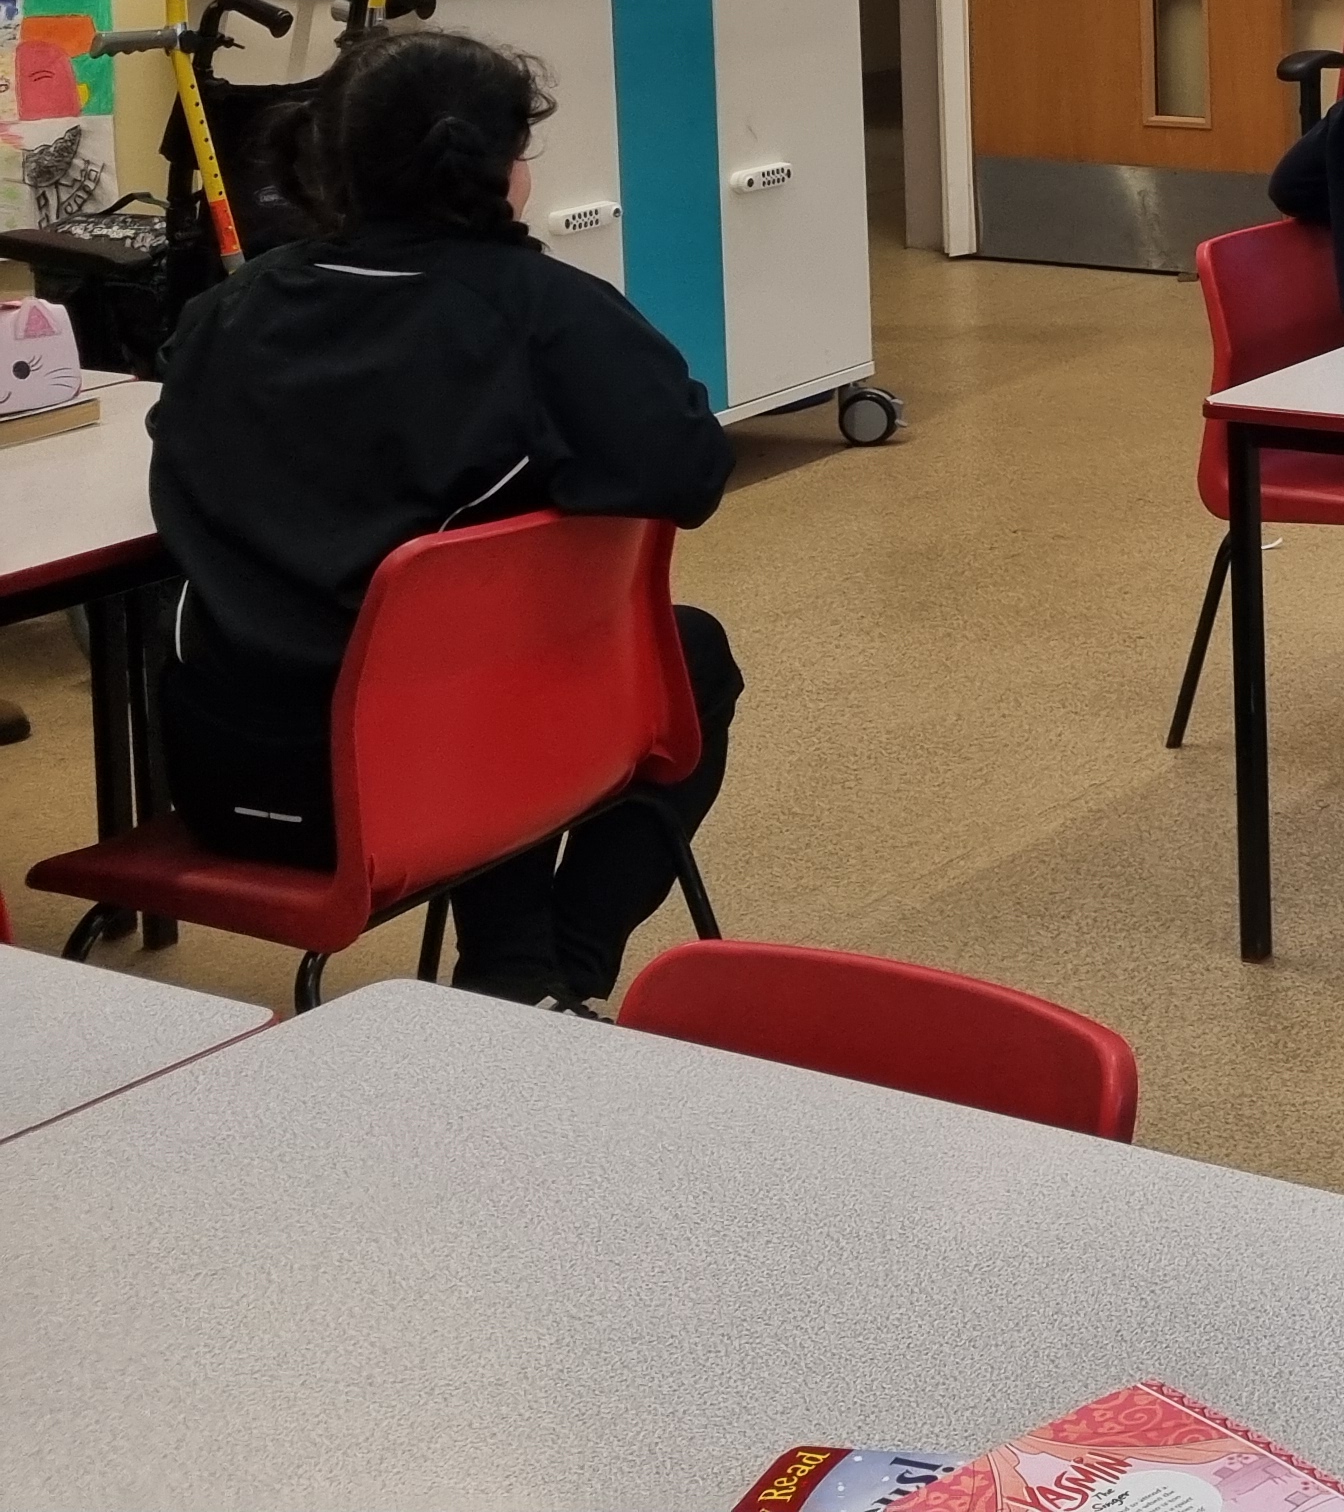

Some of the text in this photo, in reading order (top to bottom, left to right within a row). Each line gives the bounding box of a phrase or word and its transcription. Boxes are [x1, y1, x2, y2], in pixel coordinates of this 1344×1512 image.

[758, 1451, 831, 1504] Read
[1006, 1452, 1132, 1512] YASMIN
[1092, 1488, 1116, 1501] The
[1092, 1490, 1131, 1512] Singer
